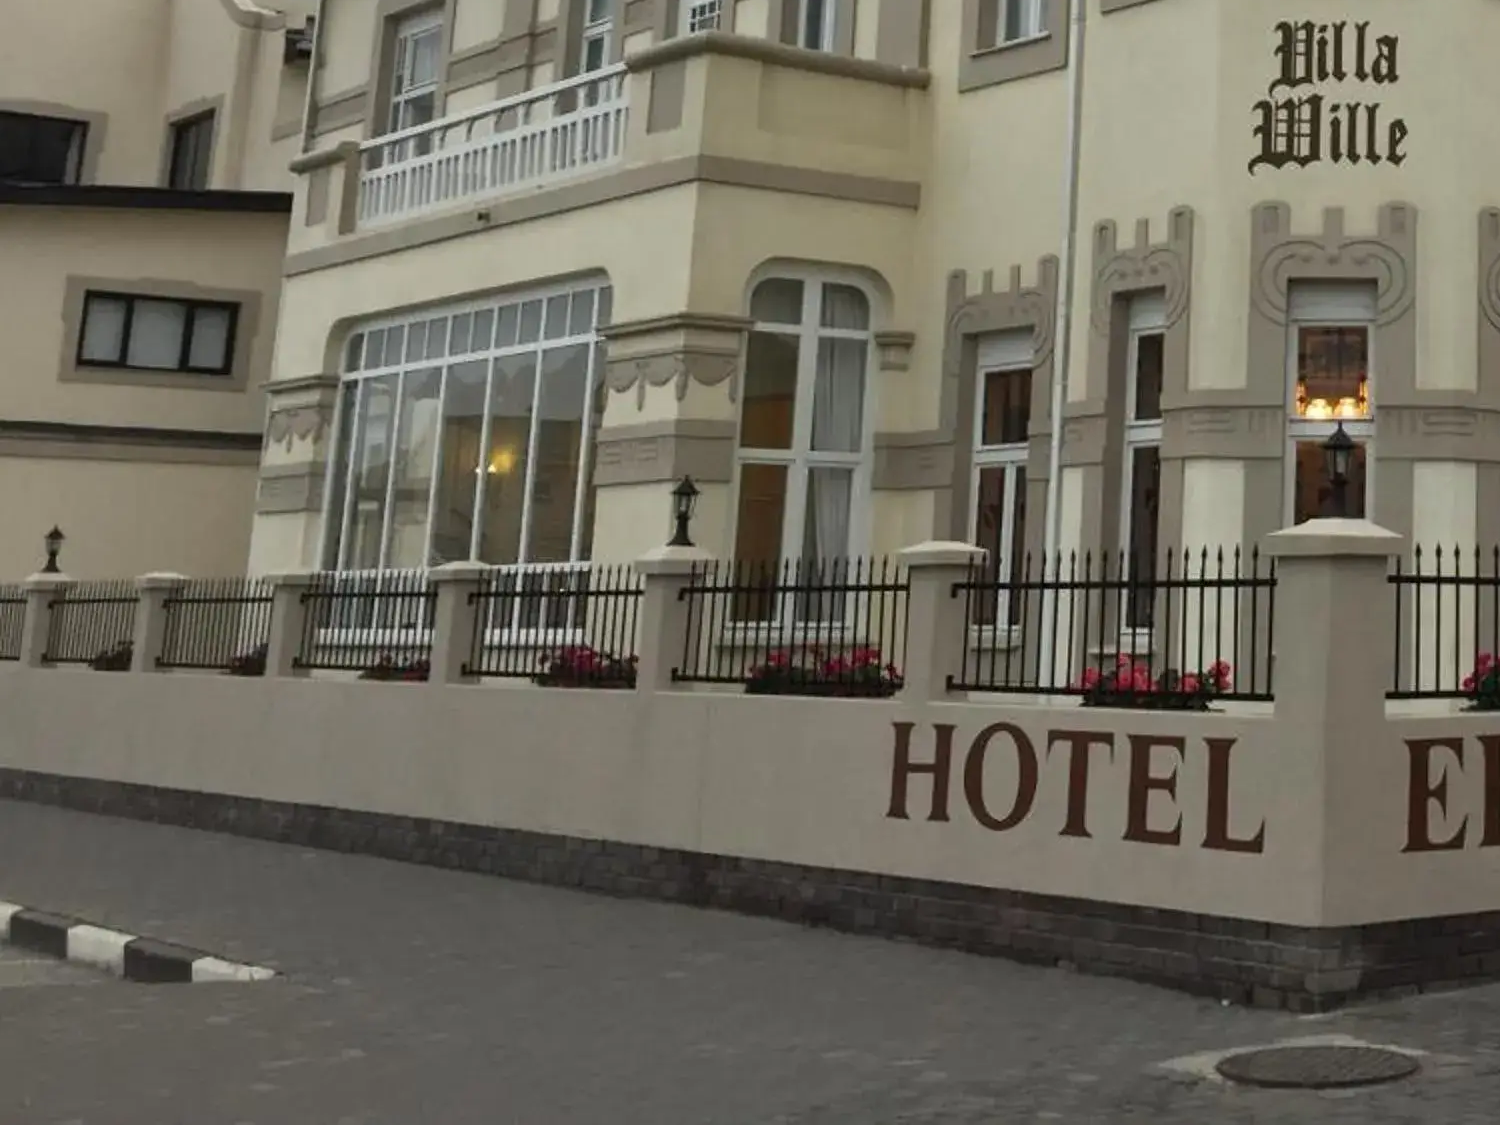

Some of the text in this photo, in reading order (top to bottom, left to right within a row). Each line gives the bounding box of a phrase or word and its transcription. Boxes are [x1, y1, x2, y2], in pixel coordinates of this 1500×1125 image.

[1268, 19, 1400, 98] Villa
[1247, 93, 1409, 176] Wille
[886, 720, 1266, 854] HOTEL
